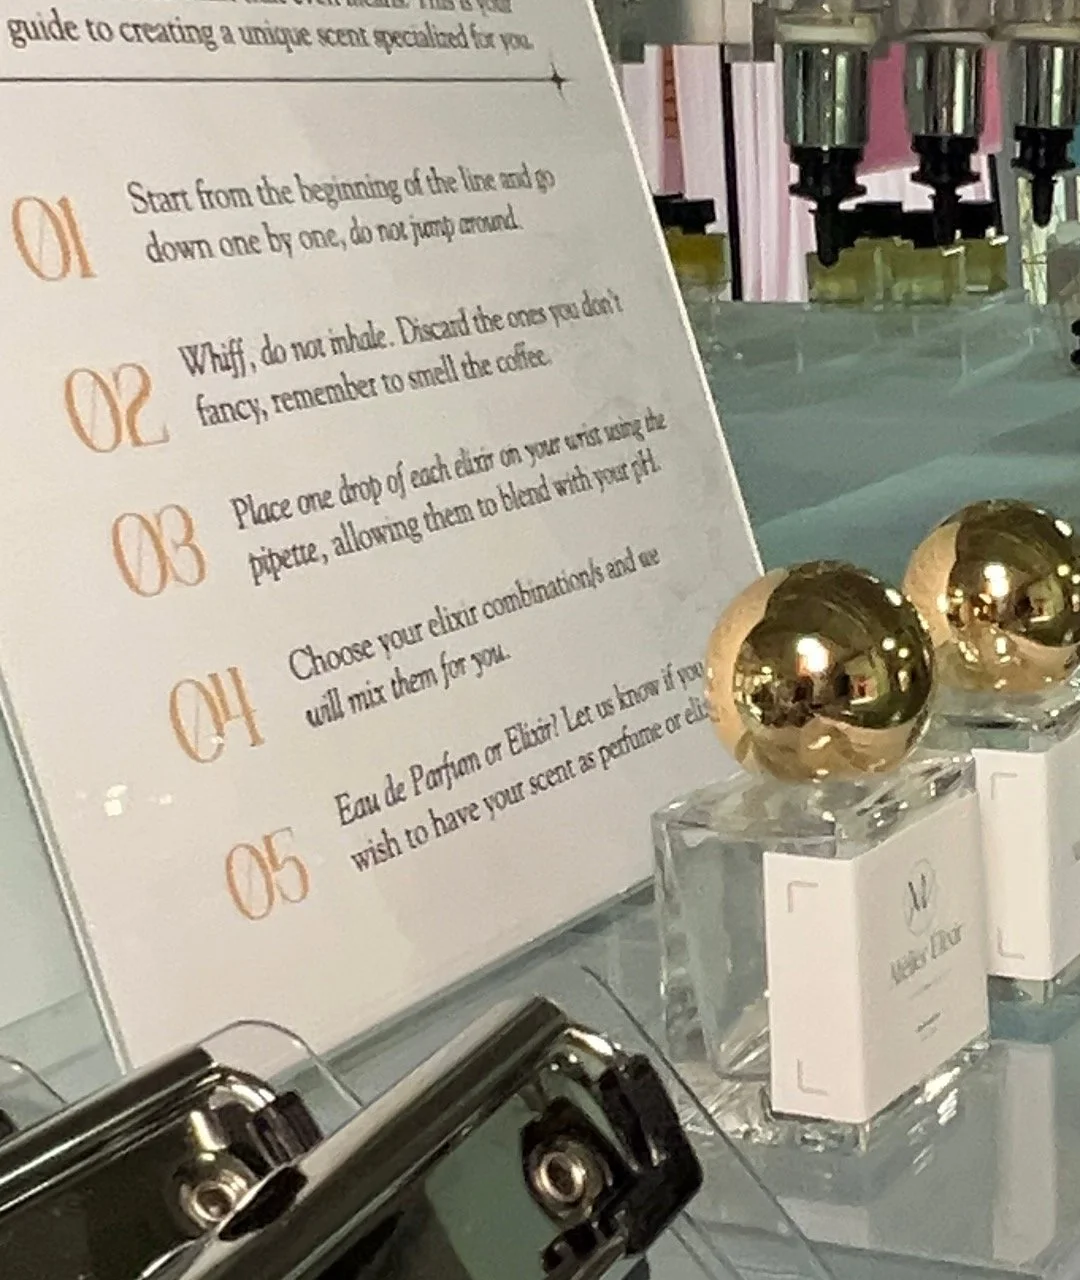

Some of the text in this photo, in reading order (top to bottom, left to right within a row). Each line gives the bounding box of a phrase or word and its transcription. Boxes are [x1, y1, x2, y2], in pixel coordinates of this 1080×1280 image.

[8, 7, 81, 49] guide
[85, 18, 115, 42] to
[119, 16, 220, 52] creating
[220, 28, 236, 46] a
[238, 19, 313, 54] unique
[316, 26, 371, 48] scent
[469, 23, 496, 50] for
[126, 161, 556, 214] Start from the beginning of the line and go
[11, 195, 98, 282] 01
[146, 230, 214, 263] down
[219, 235, 263, 257] one
[261, 222, 294, 258] by
[299, 226, 348, 251] one,
[350, 215, 374, 246] do
[379, 220, 409, 242] not
[410, 215, 456, 246] jump
[260, 333, 288, 366] do
[291, 339, 327, 362] not
[396, 307, 471, 345] Discard
[473, 305, 505, 333] the
[507, 307, 548, 330] ones
[549, 301, 578, 328] you
[64, 363, 170, 452] 02
[197, 394, 270, 427] fancy,
[271, 370, 379, 415] remember
[382, 372, 406, 394] to
[408, 353, 460, 390] smell
[460, 350, 495, 380] the
[230, 406, 668, 530] Place one drop of each elixir on your wrist using the
[112, 503, 208, 597] 03
[248, 540, 330, 586] pipette,
[331, 515, 424, 557] allowing
[423, 501, 475, 533] them
[477, 495, 498, 517] to
[497, 472, 553, 512] blend
[553, 464, 594, 497] with
[592, 459, 631, 494] your
[289, 638, 376, 680] Choose
[377, 623, 424, 661] your
[428, 602, 480, 637] elixir
[605, 545, 638, 579] and
[638, 548, 661, 569] we
[169, 667, 266, 763] 04
[304, 687, 346, 728] will
[348, 681, 388, 715] mix
[390, 666, 440, 700] them
[440, 650, 477, 690] for
[334, 792, 382, 826] Eau
[384, 773, 408, 808] de
[409, 750, 483, 796] Parfum
[484, 742, 503, 766] or
[560, 705, 595, 733] Let
[596, 697, 616, 719] us
[613, 683, 660, 711] know
[660, 661, 676, 691] if
[350, 713, 682, 872] wish to have your scent as perfume or
[225, 827, 310, 921] 05
